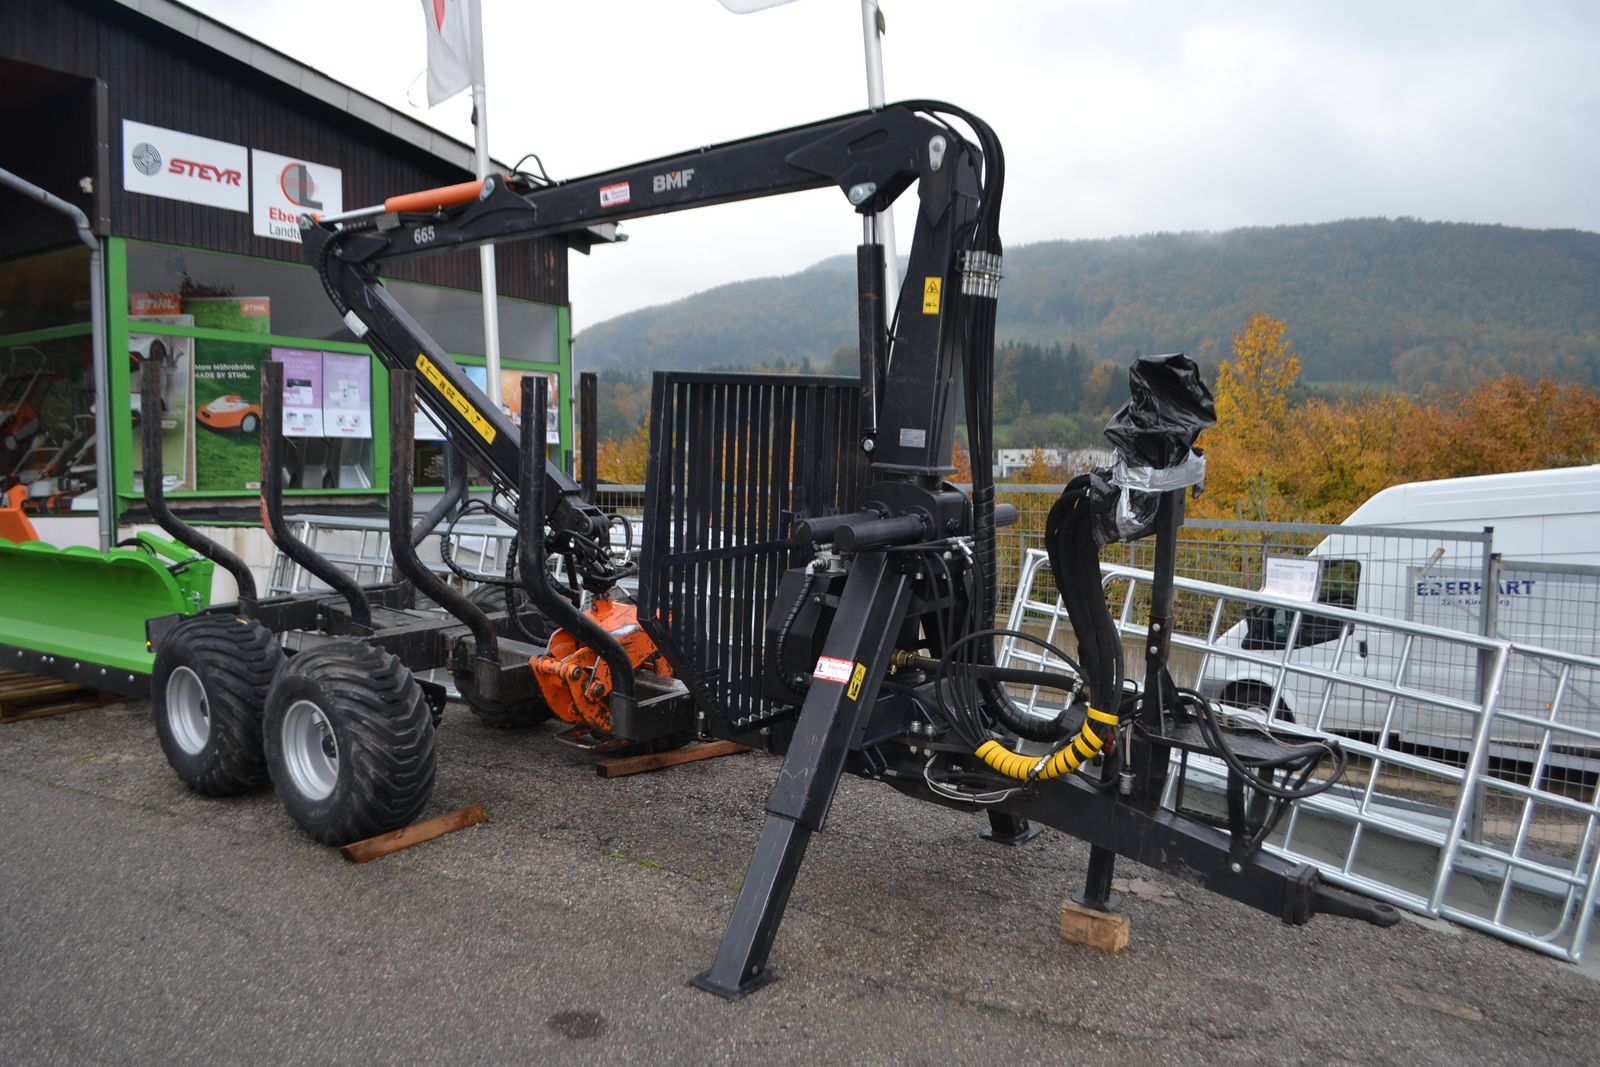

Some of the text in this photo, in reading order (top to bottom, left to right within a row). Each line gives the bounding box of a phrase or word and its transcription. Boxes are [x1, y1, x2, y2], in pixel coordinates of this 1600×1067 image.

[168, 157, 242, 187] STEYR
[653, 168, 696, 193] BMF
[269, 207, 300, 224] Eber
[413, 225, 436, 245] 665
[216, 371, 226, 379] BY
[1416, 580, 1535, 597] EBERHRT
